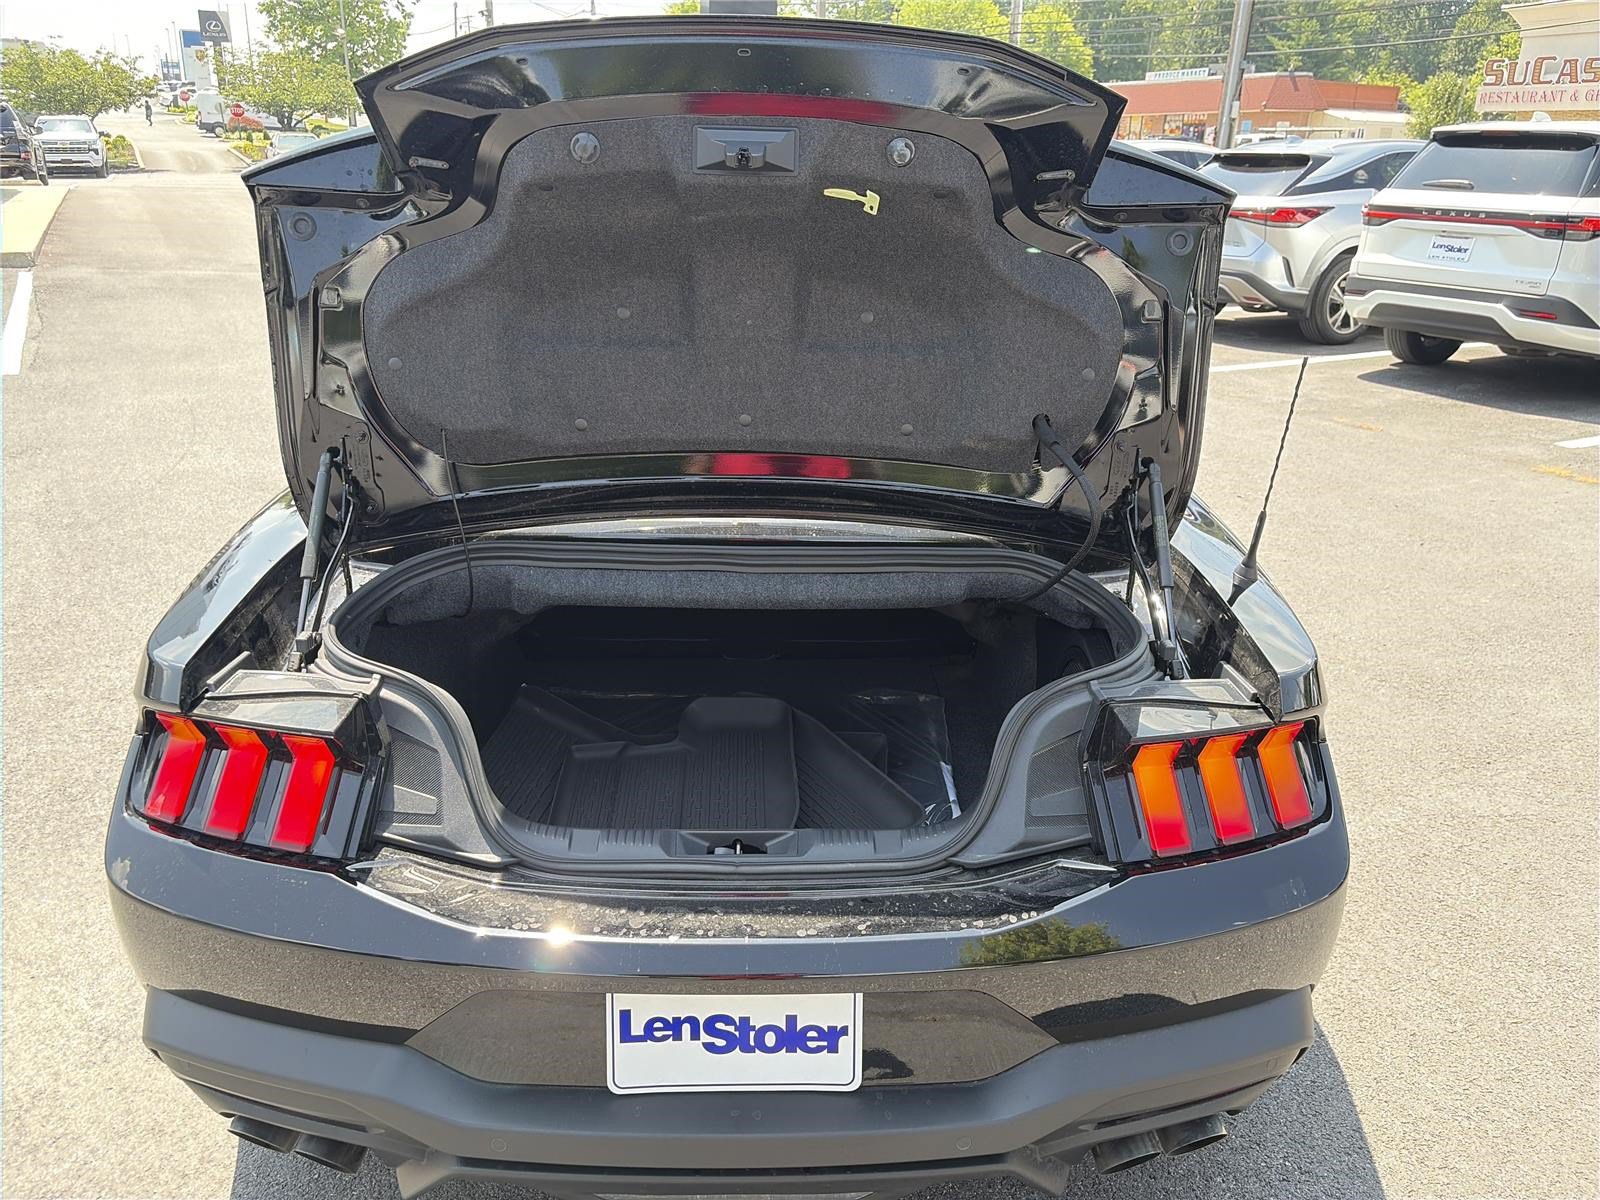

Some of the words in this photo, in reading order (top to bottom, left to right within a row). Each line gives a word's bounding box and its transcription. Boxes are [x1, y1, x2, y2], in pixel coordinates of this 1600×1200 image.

[1479, 90, 1566, 104] RESTAURANT
[1569, 90, 1579, 102] &
[1422, 209, 1486, 218] LEXUS
